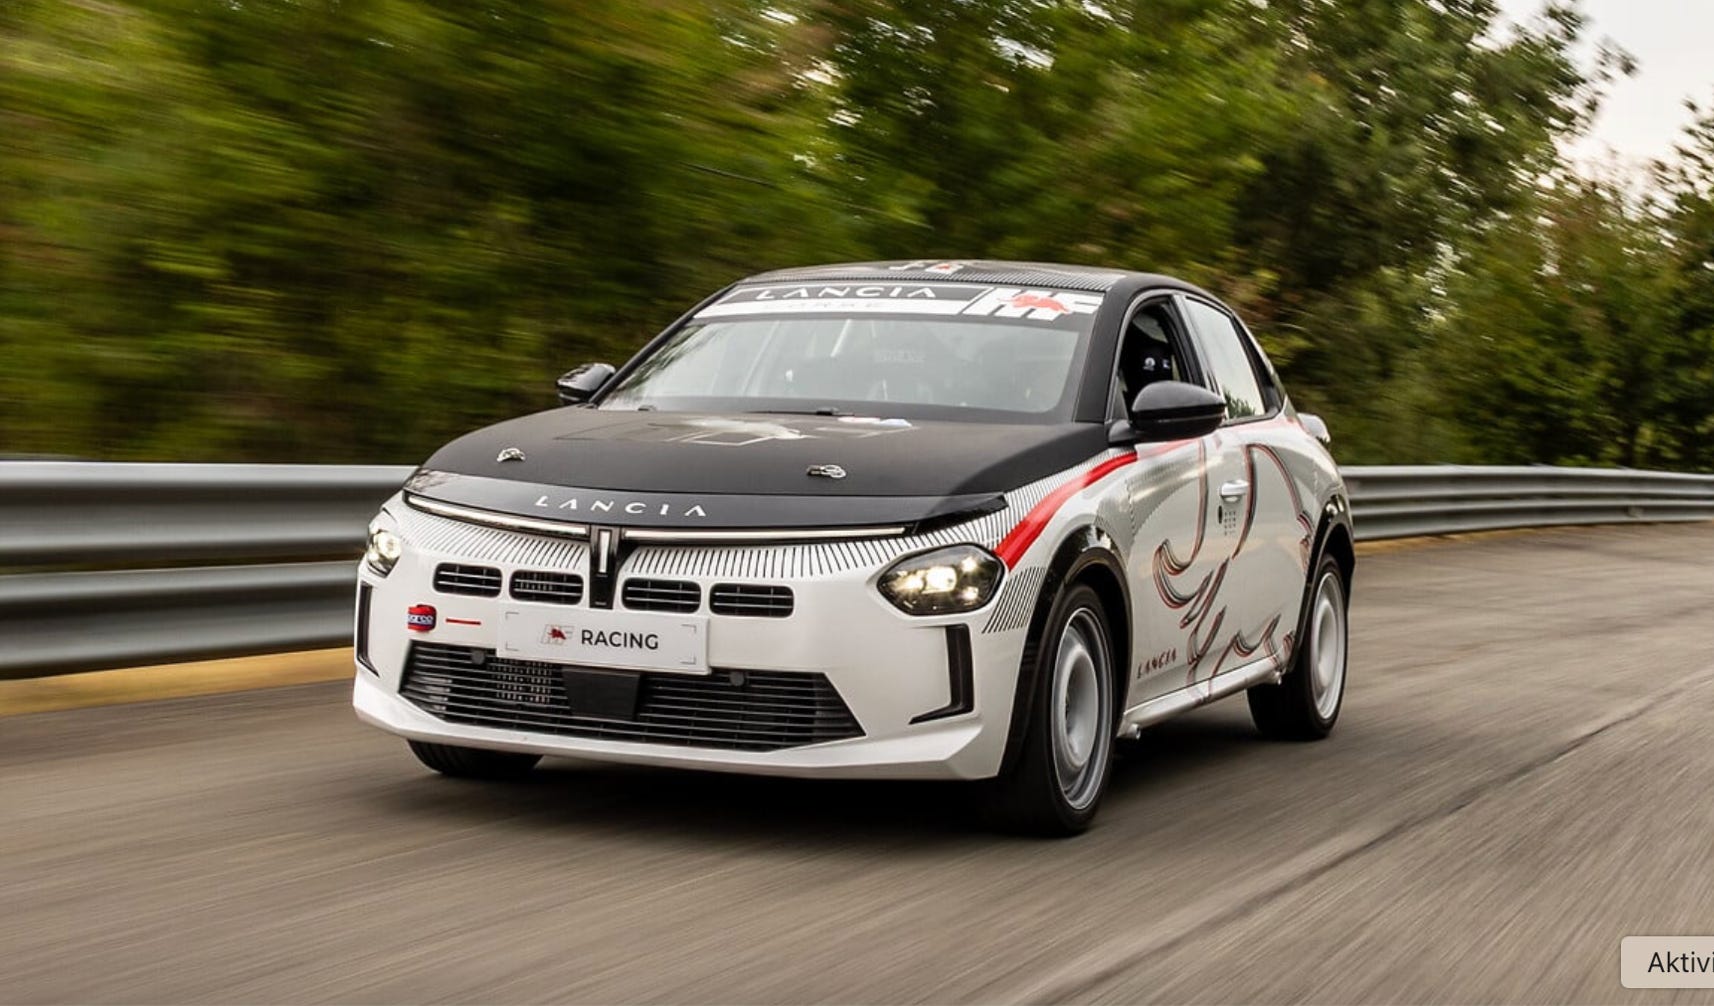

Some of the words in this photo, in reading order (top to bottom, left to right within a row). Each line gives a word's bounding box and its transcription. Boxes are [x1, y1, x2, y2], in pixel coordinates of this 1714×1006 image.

[756, 286, 937, 300] LANCIA
[534, 495, 707, 518] LANCIA
[581, 629, 659, 650] RACING
